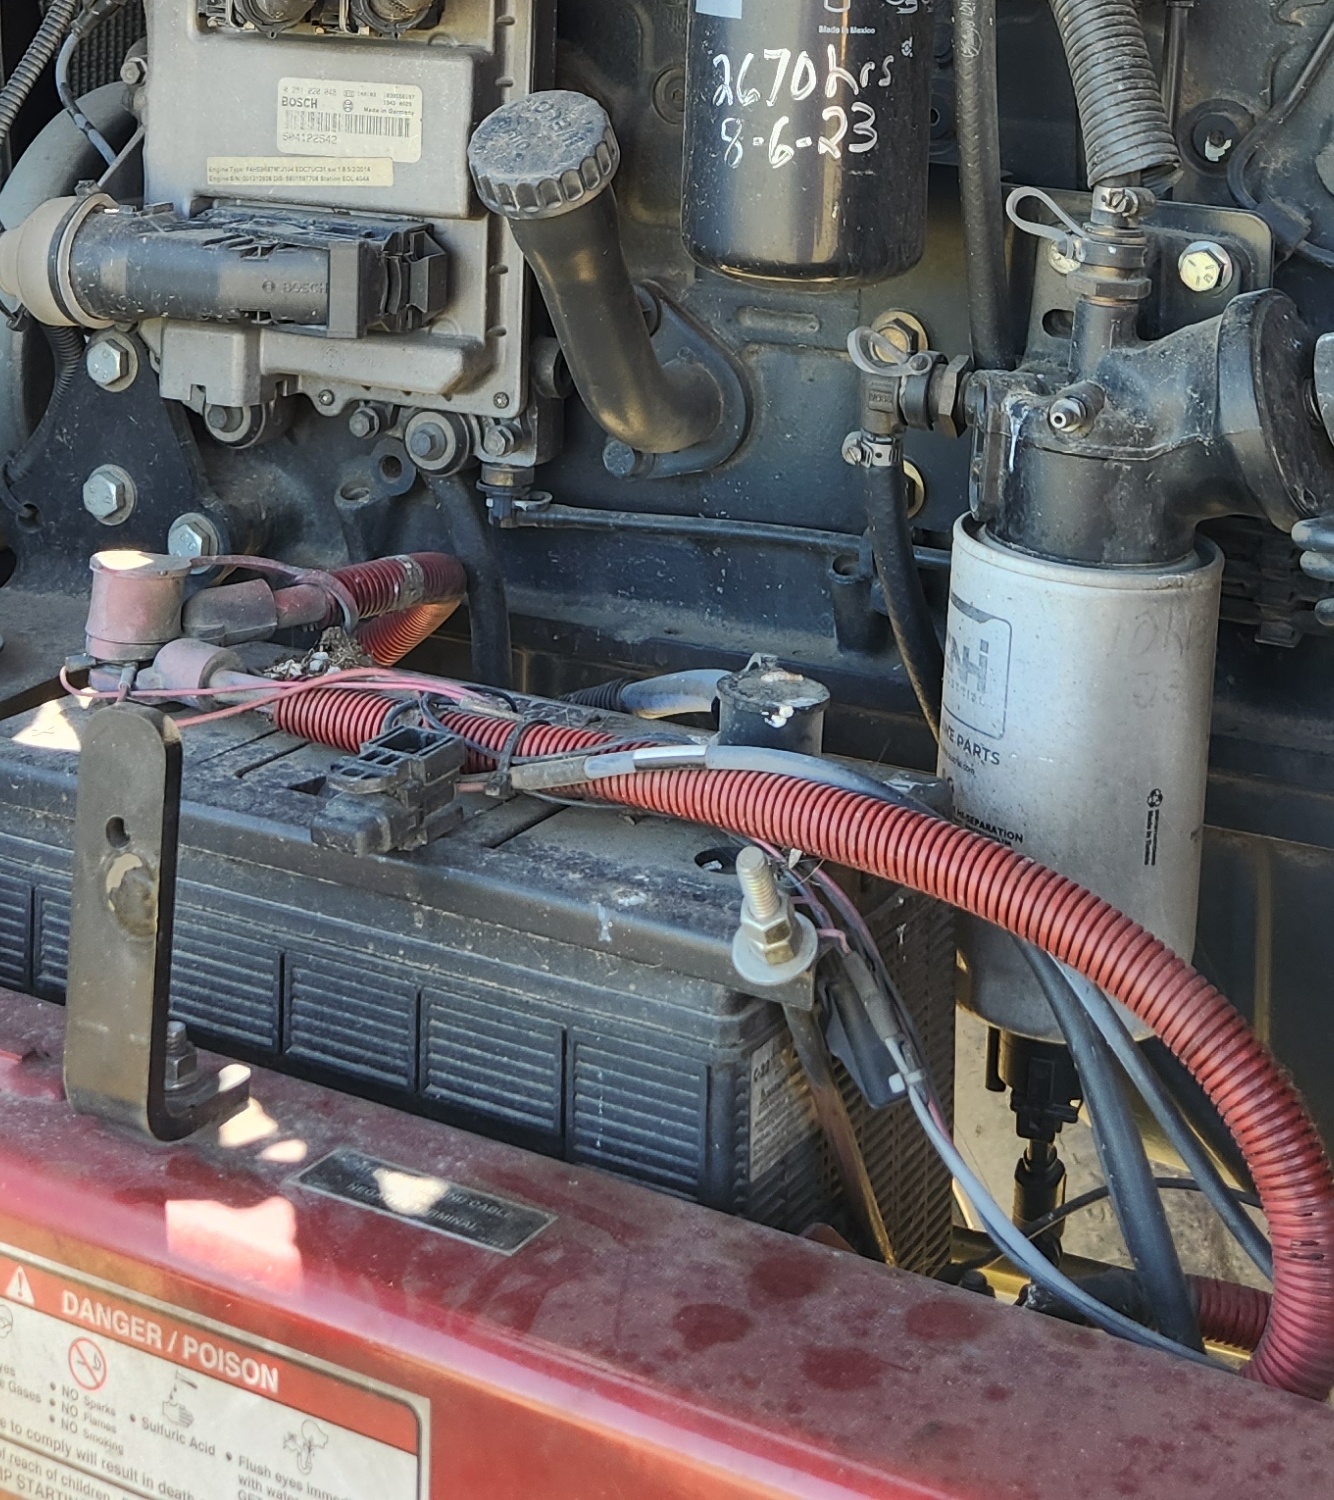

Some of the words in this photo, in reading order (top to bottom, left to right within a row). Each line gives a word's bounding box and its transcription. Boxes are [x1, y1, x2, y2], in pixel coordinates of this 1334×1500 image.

[818, 25, 841, 35] Made
[850, 26, 876, 35] Mexico
[281, 96, 318, 110] BOSCH
[721, 101, 878, 169] 8-6-23
[282, 282, 328, 294] BOSCH
[956, 734, 1000, 766] PARTS
[62, 1289, 162, 1349] DANGER
[168, 1330, 177, 1352] /
[183, 1334, 279, 1393] POISON
[9, 1381, 42, 1403] Gases
[62, 1385, 79, 1401] NO
[84, 1395, 116, 1417] Sparks
[61, 1402, 79, 1417] NO
[84, 1413, 117, 1434] Flames
[61, 1418, 78, 1434] NO
[83, 1428, 124, 1456] Smoking
[141, 1416, 186, 1446] Sulfuric
[190, 1435, 216, 1457] Acid
[9, 1451, 43, 1476] reach
[46, 1466, 58, 1481] of
[10, 1420, 23, 1434] to
[26, 1426, 72, 1458] comply
[76, 1446, 98, 1466] will
[101, 1458, 138, 1486] result
[142, 1471, 154, 1489] in
[238, 1455, 271, 1480] Flush
[275, 1472, 303, 1492] eyes
[238, 1472, 263, 1493] with
